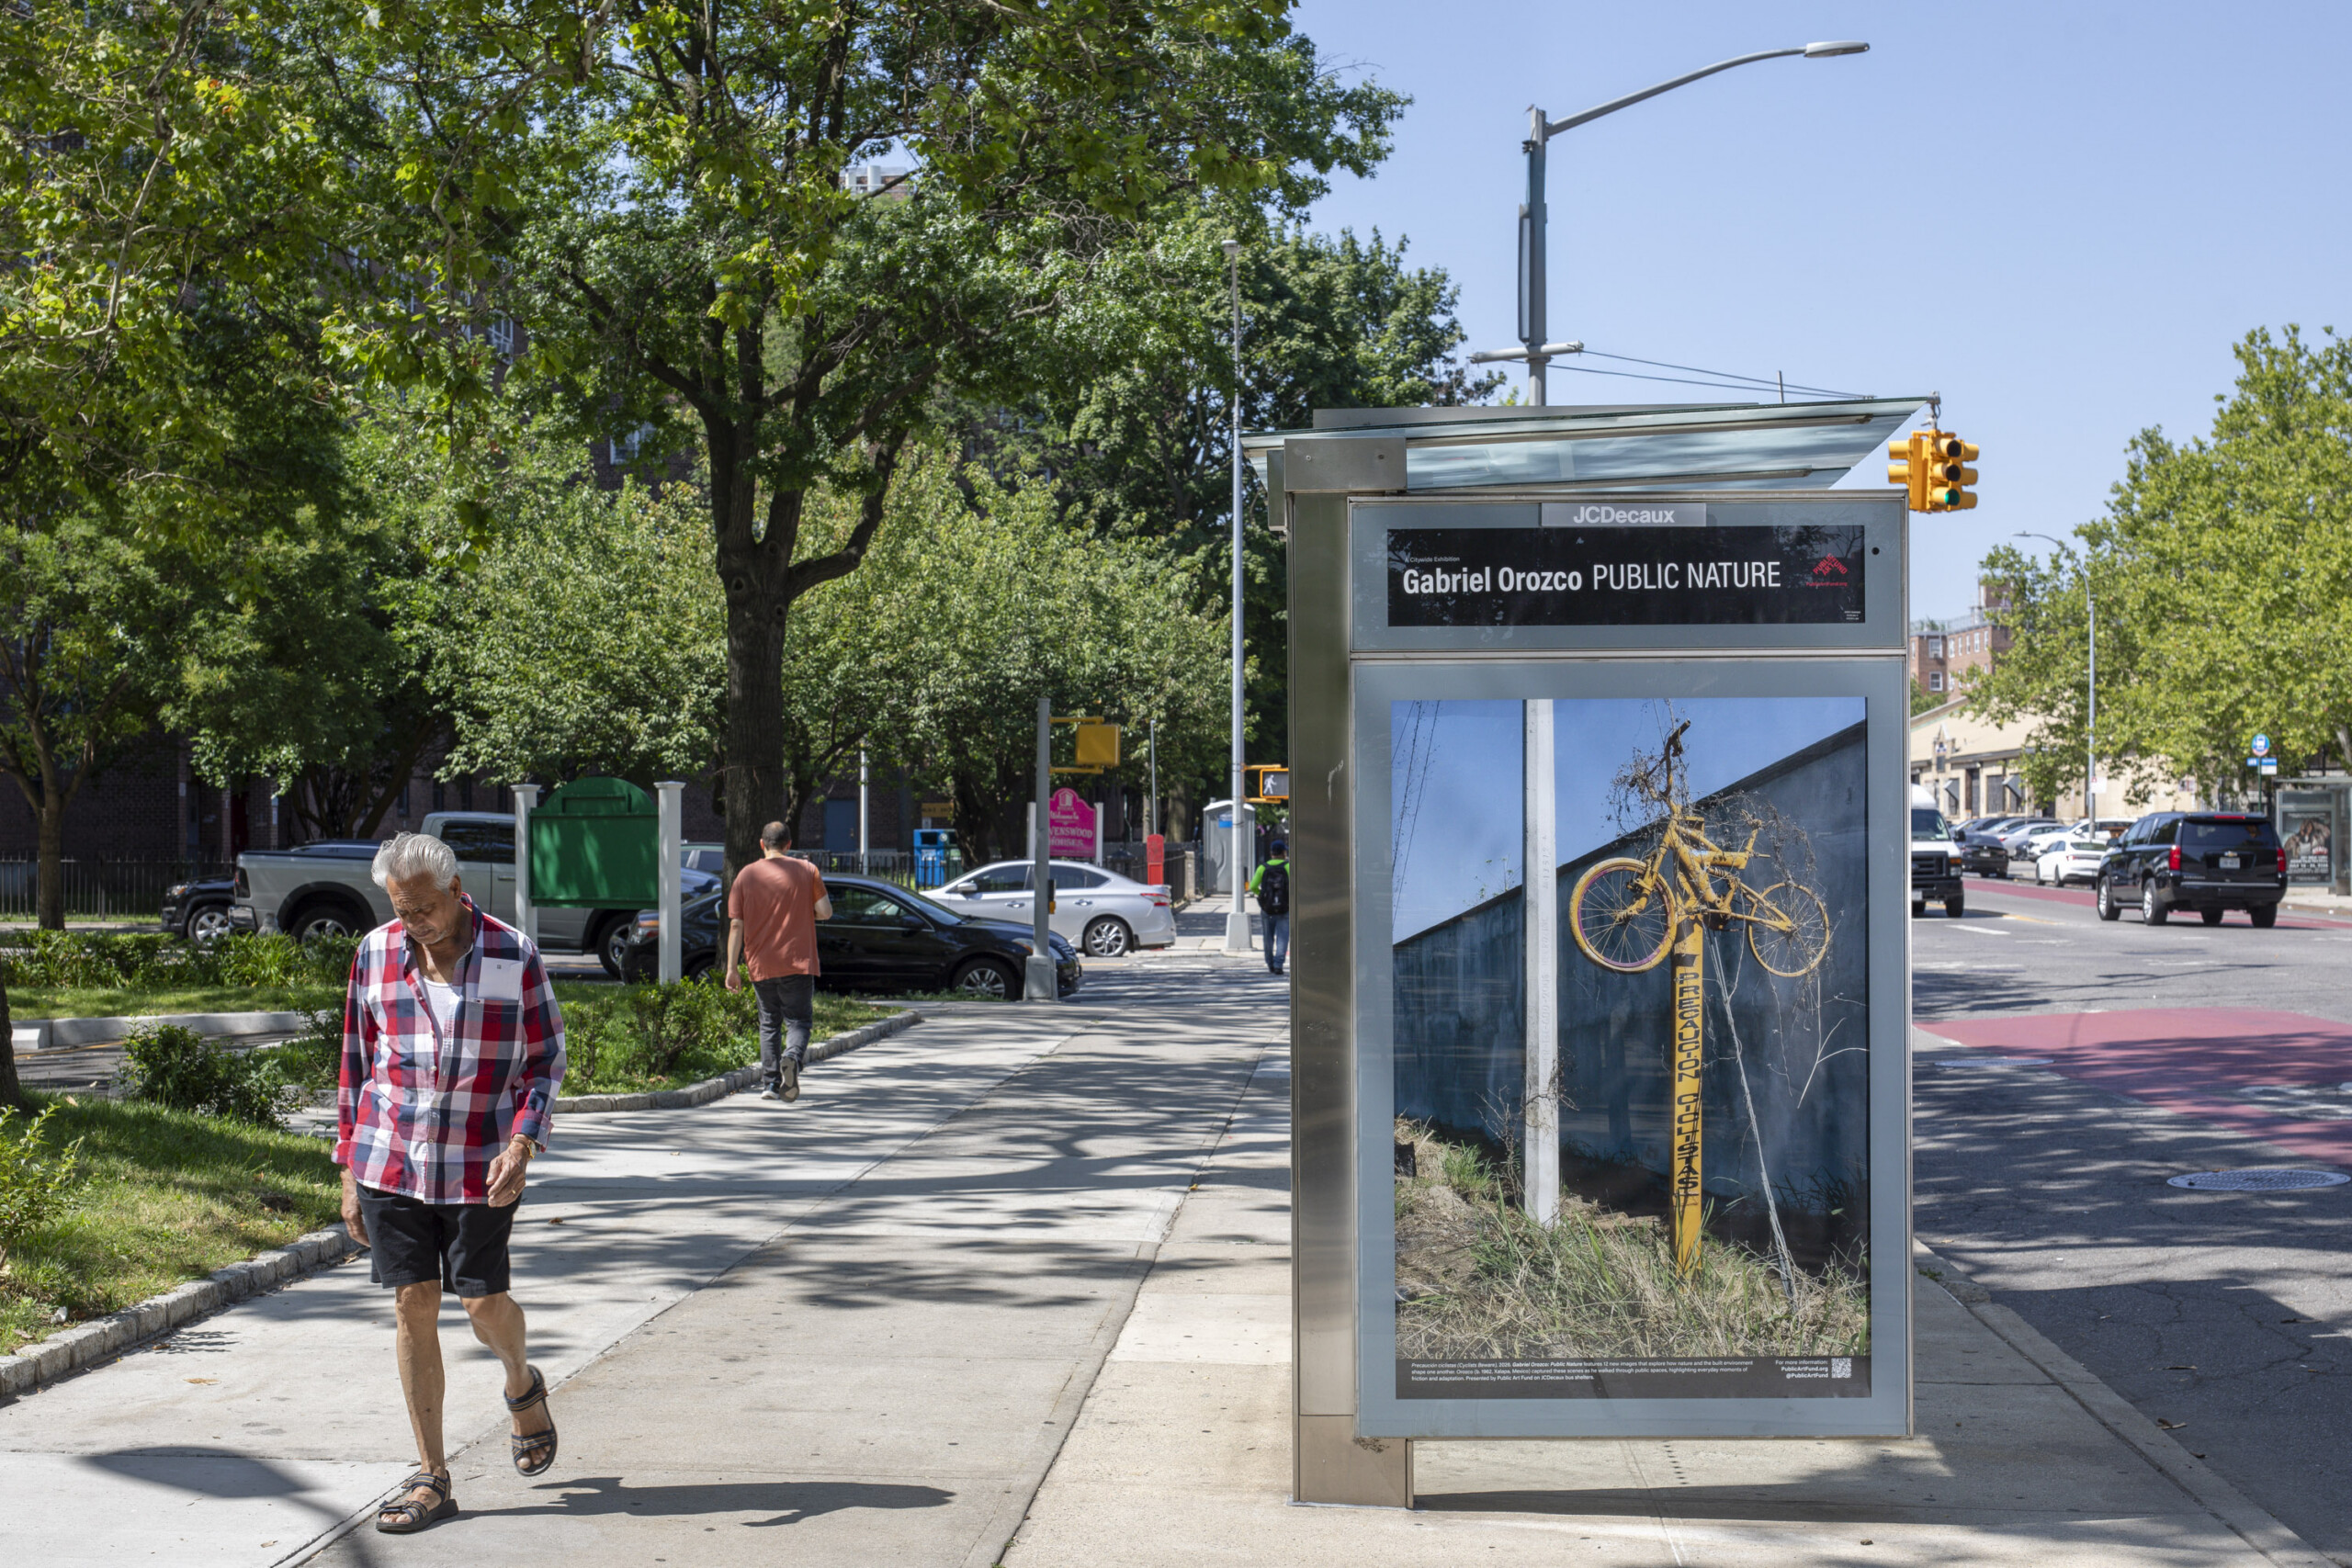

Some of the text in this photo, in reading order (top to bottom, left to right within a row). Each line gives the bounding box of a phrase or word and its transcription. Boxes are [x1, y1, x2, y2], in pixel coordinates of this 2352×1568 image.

[1573, 506, 1675, 524] JCDecaux
[1813, 553, 1832, 575] PUBLIC
[1830, 556, 1848, 575] FUND
[1403, 562, 1781, 594] Gabriel Orozco PUBLIC NATURE
[1050, 826, 1093, 838] VENSWOOD
